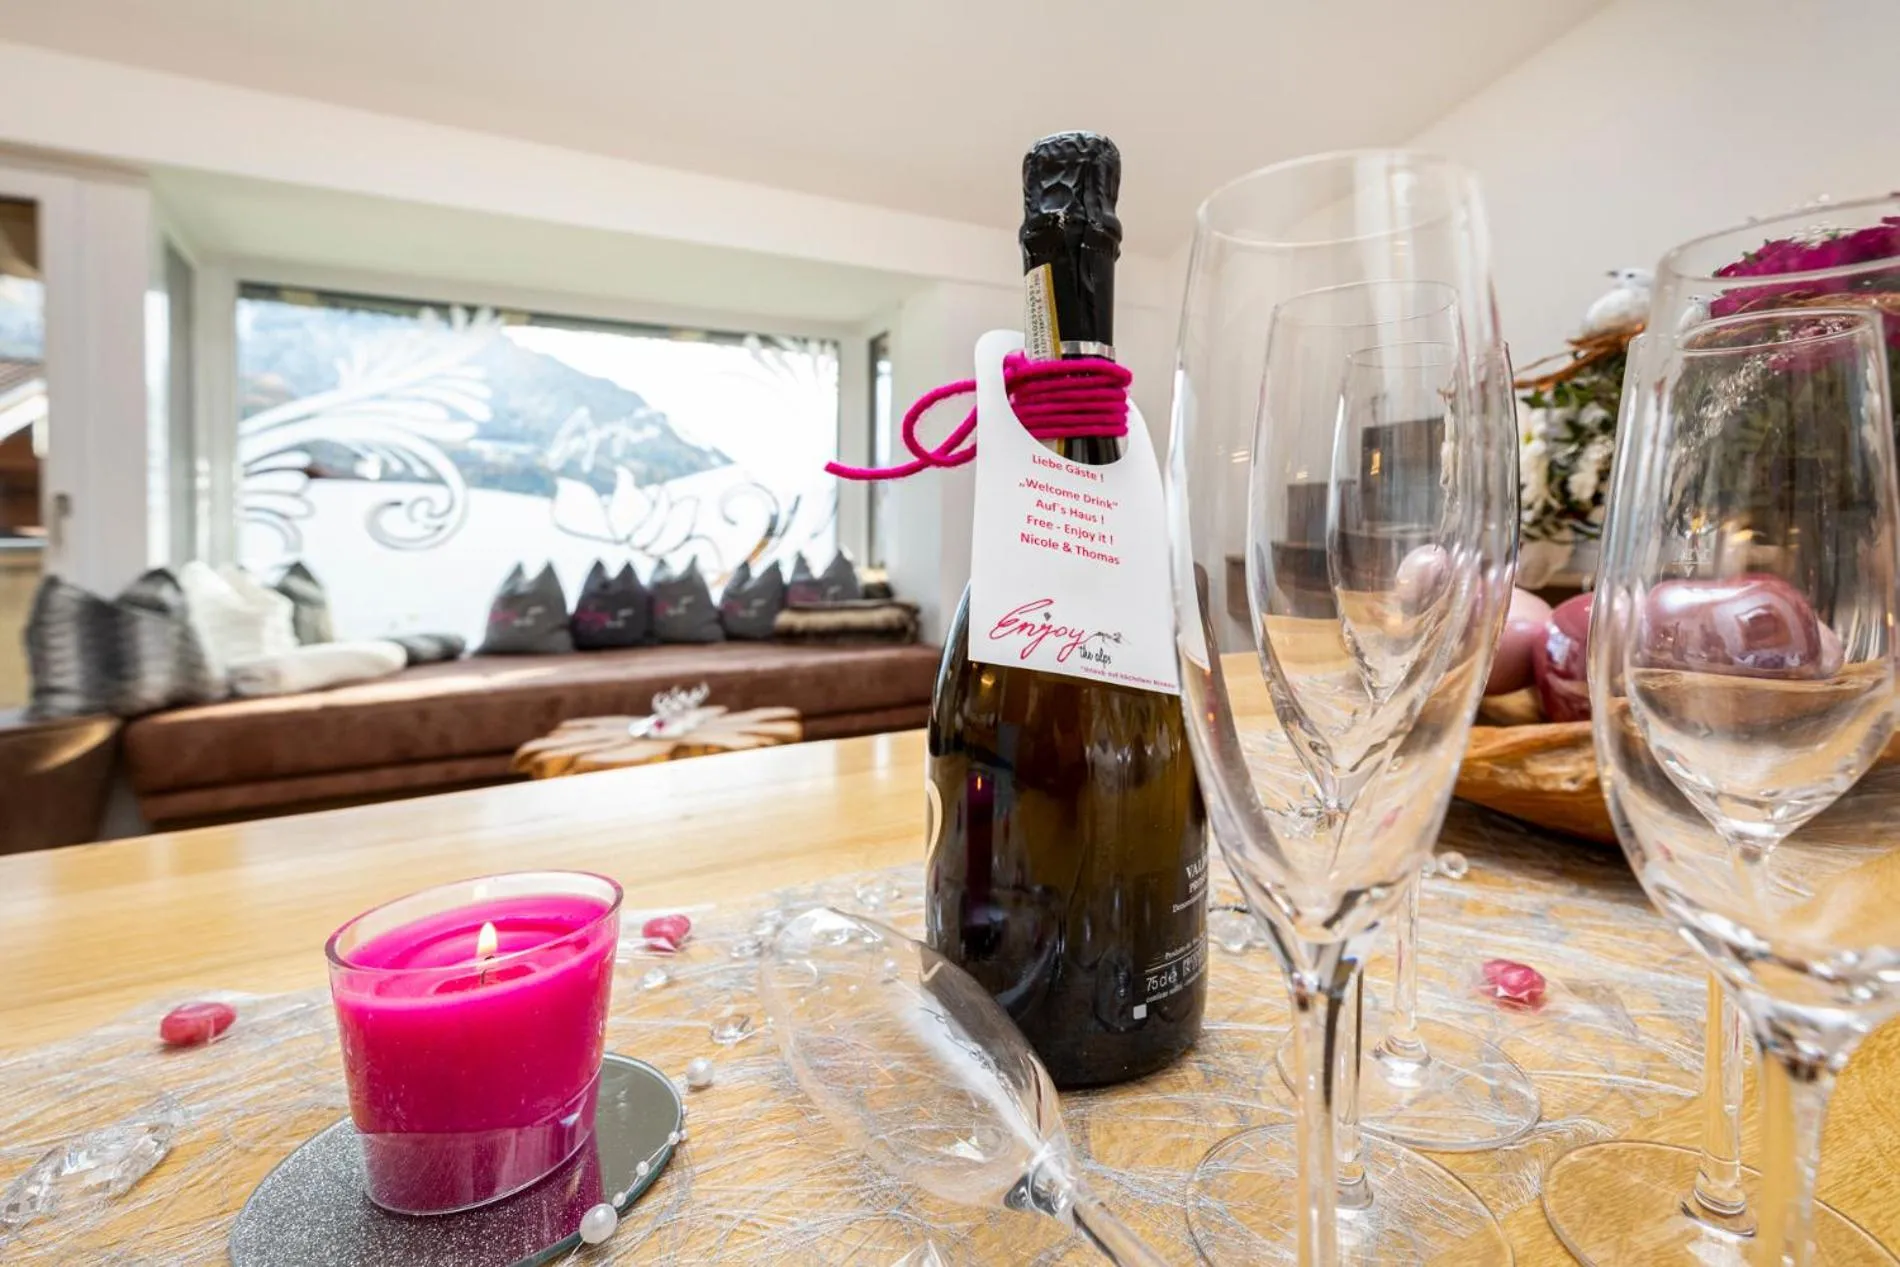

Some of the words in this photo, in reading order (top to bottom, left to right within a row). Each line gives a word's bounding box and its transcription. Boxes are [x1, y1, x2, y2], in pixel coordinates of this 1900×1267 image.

[1032, 454, 1063, 470] Liebe
[1065, 464, 1098, 480] Gäste
[1100, 473, 1105, 483] !
[1026, 515, 1054, 529] Free
[1064, 524, 1096, 542] Enjoy
[1098, 533, 1107, 544] it
[1069, 507, 1098, 523] Haus
[1101, 515, 1105, 524] !
[1020, 532, 1060, 550] Nicole
[1062, 542, 1073, 553] &
[1075, 545, 1121, 565] Thomas
[990, 598, 1085, 662] Enjoy
[1080, 645, 1094, 661] the
